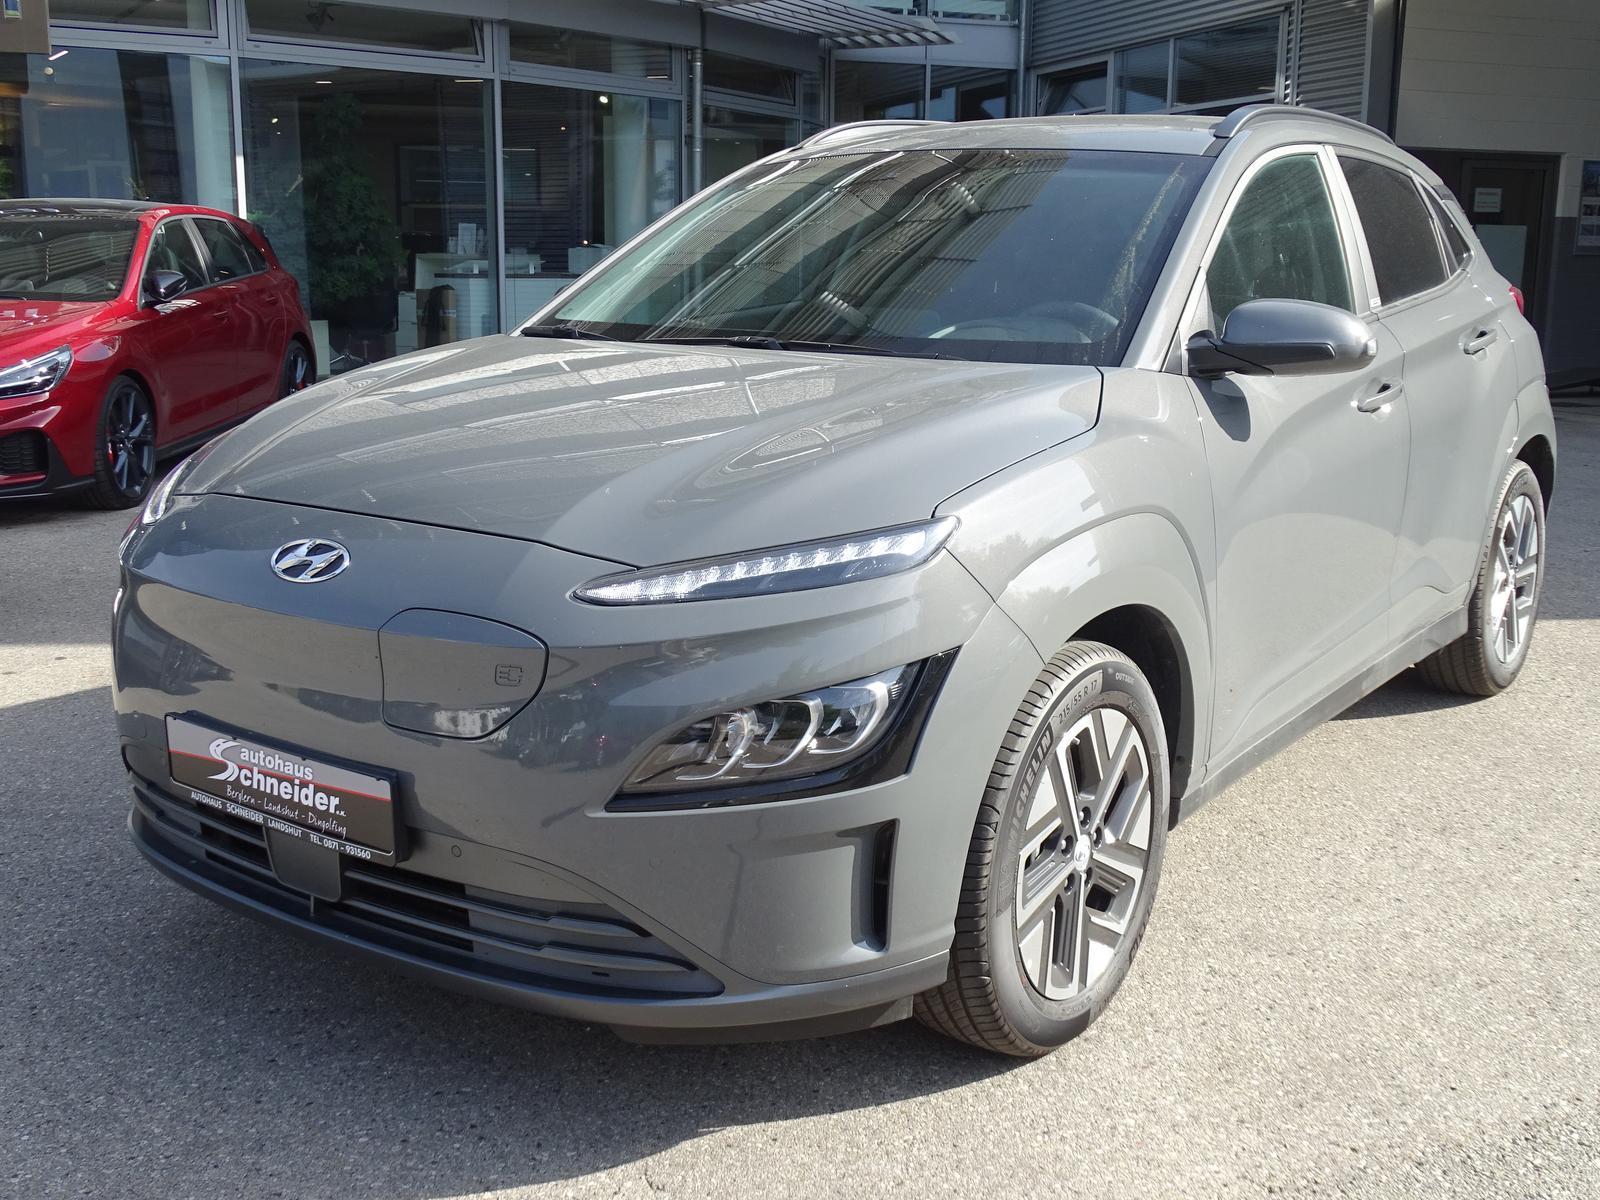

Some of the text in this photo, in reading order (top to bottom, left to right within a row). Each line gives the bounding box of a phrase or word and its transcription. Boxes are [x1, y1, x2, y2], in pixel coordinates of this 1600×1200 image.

[240, 747, 313, 780] autohaus
[190, 791, 223, 809] AUTOHAUS
[226, 803, 264, 824] SCHNEIDER
[267, 818, 303, 838] LANDSHUT
[323, 838, 339, 851] 0871
[345, 845, 371, 860] 931560
[226, 784, 256, 805] Berglern
[263, 797, 299, 819] Landshut
[308, 811, 347, 840] Dingolfing
